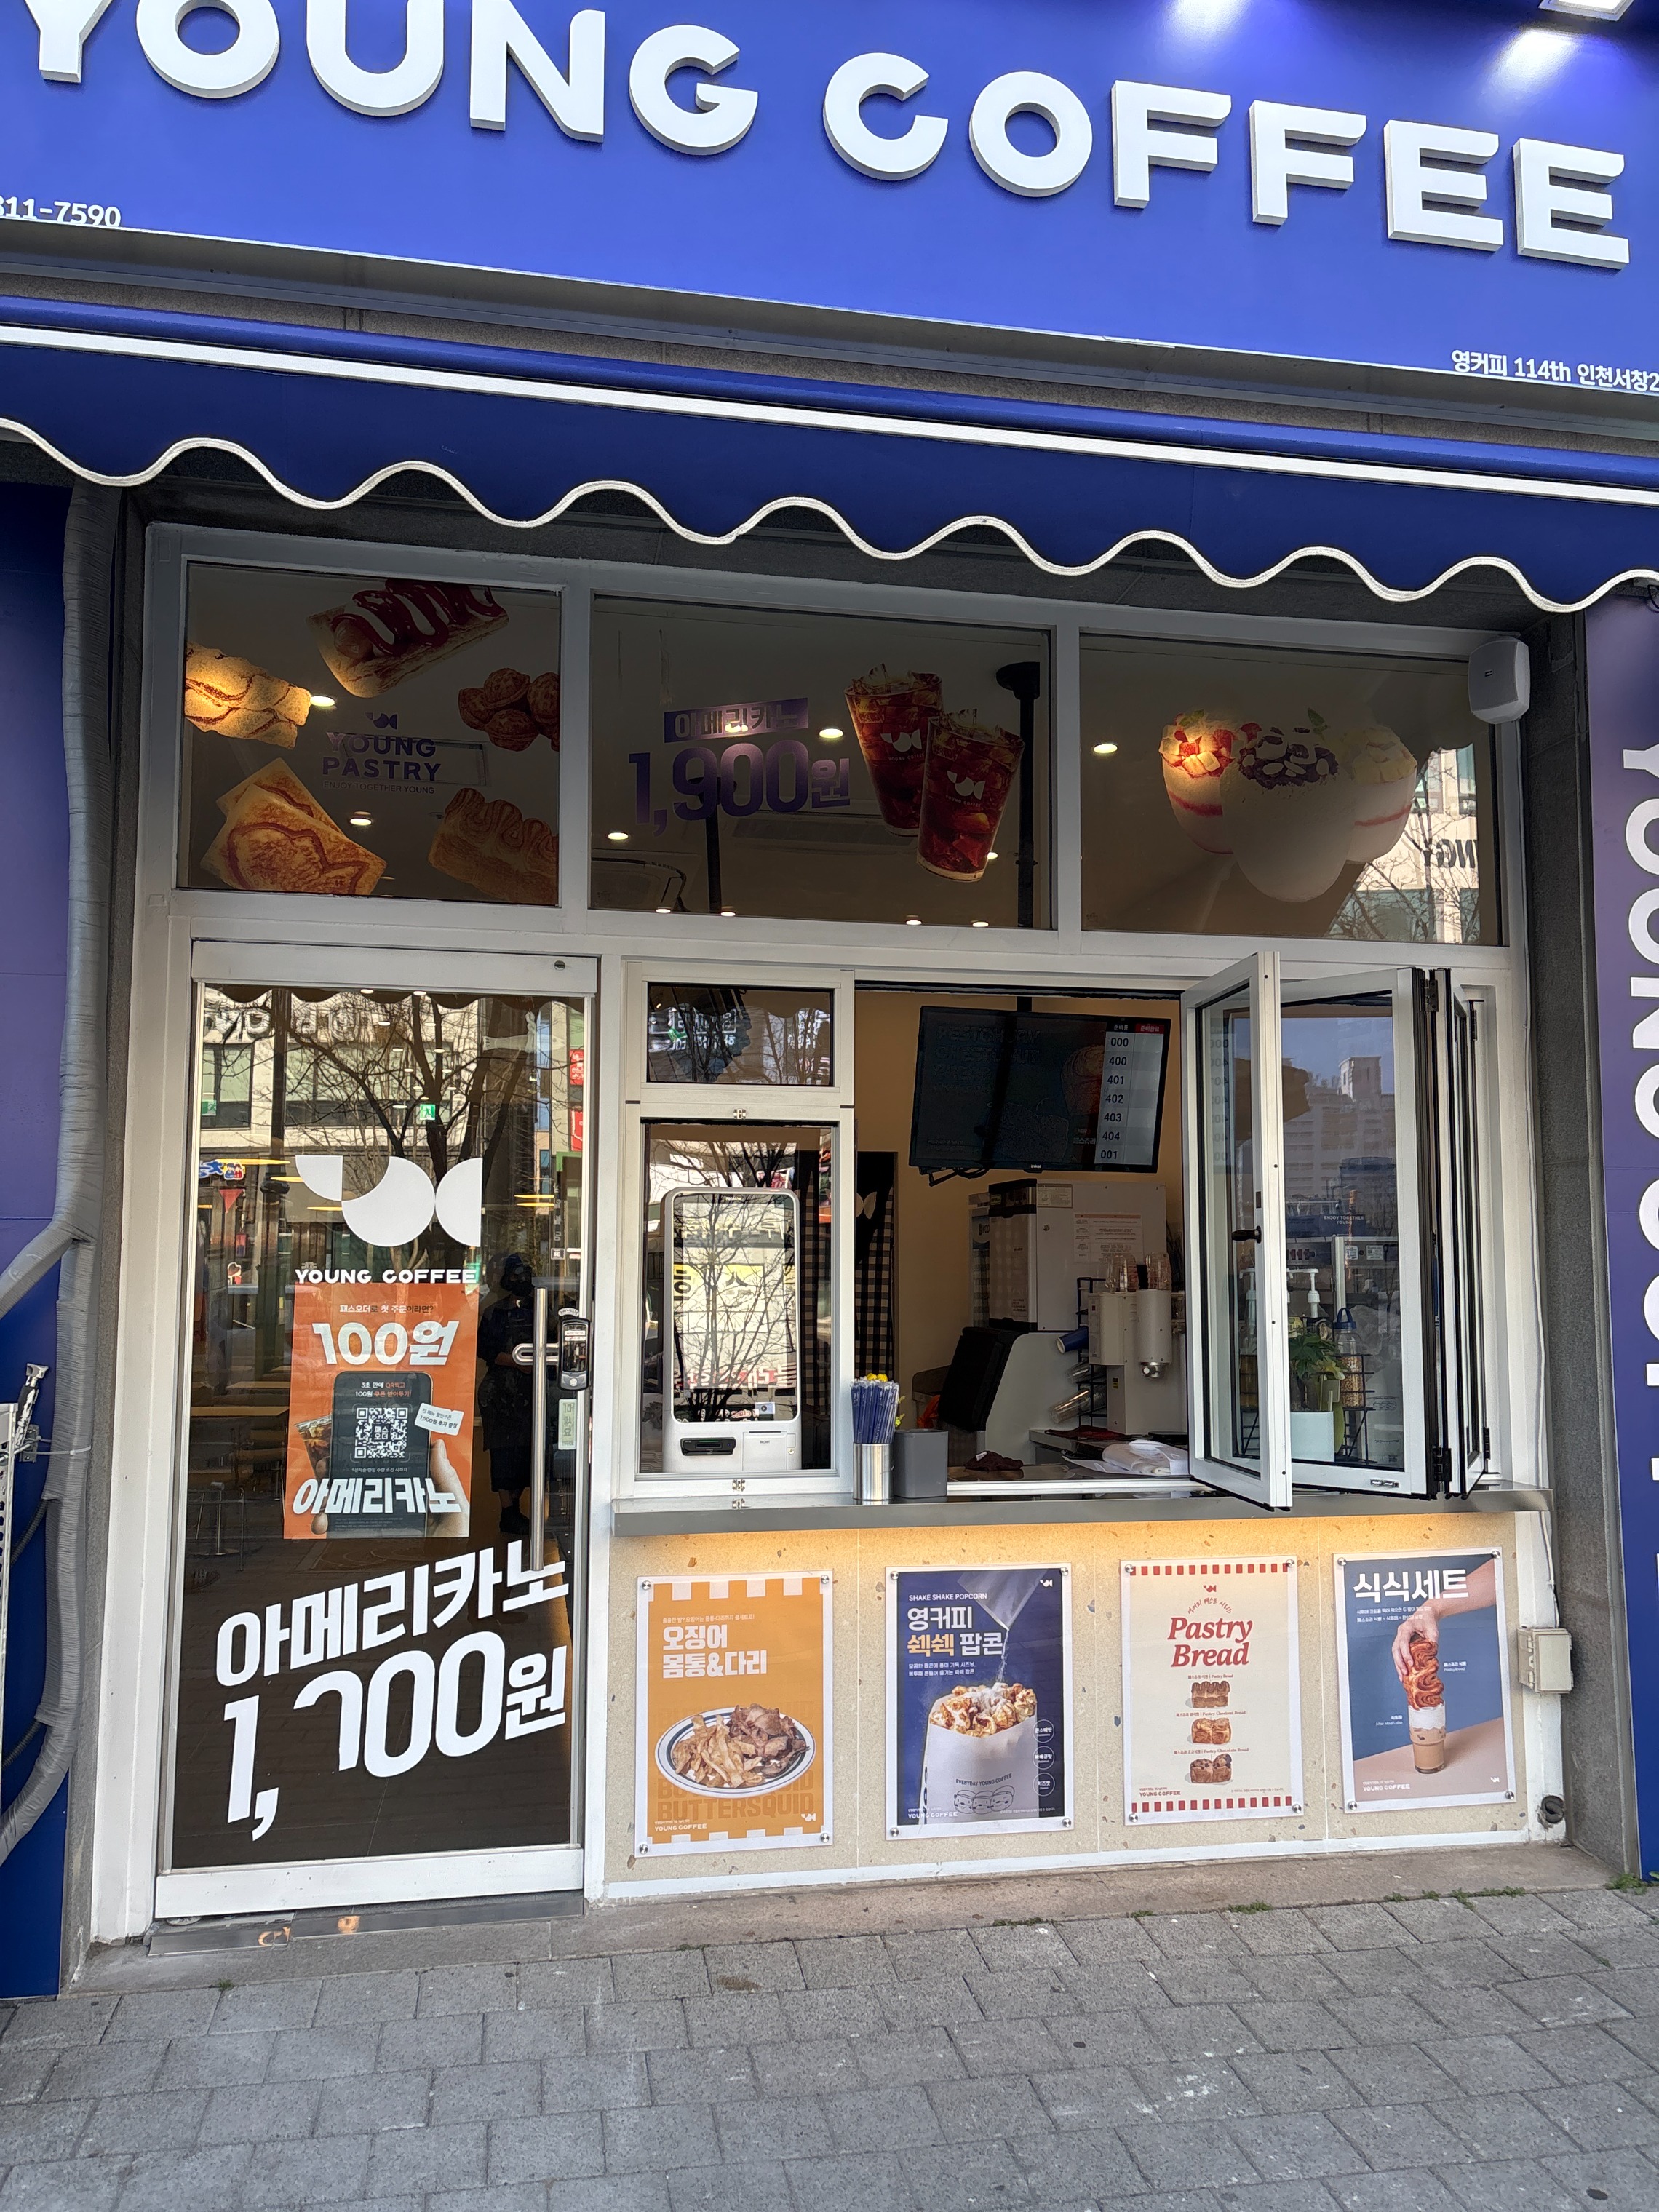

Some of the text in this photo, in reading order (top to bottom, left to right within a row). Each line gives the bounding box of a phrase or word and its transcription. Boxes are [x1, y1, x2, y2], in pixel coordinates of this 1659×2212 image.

[23, 0, 1630, 270] YOUNG COFFEE
[1451, 349, 1508, 376] 영커피
[1513, 357, 1572, 382] 114th
[675, 704, 799, 738] 아메리카노
[326, 732, 436, 757] YOUNG
[322, 757, 442, 781] PASTRY
[324, 781, 435, 794] ENJOY TOGETHER YOUNG
[629, 739, 851, 836] 1,900원
[1110, 1038, 1129, 1047] 000
[1109, 1057, 1127, 1066] 400
[1107, 1075, 1125, 1084] 401
[1105, 1094, 1123, 1103] 402
[1104, 1113, 1122, 1122] 403
[1102, 1131, 1121, 1141] 404
[1100, 1150, 1118, 1159] 001
[295, 1268, 477, 1284] YOUNG COFFEE
[339, 1304, 434, 1313] 패스오더로 첫 주문이라면?
[311, 1320, 460, 1366] 100원
[293, 1477, 461, 1516] 아메리카노
[1353, 1569, 1469, 1603] 식식세트
[216, 1540, 569, 1687] 아메리카노
[907, 1606, 972, 1631] 영커피
[663, 1624, 728, 1651] 오징어
[1167, 1617, 1253, 1643] Pastry
[907, 1632, 1003, 1658] 쉑쉑 팝콘
[1171, 1642, 1250, 1668] Bread
[663, 1650, 767, 1679] 몸통&다리
[223, 1631, 567, 1842] 1,700원
[955, 1778, 979, 1786] EVERYDAY
[995, 1773, 1012, 1783] COFFEE
[658, 1792, 814, 1821] BUTTERSQUID
